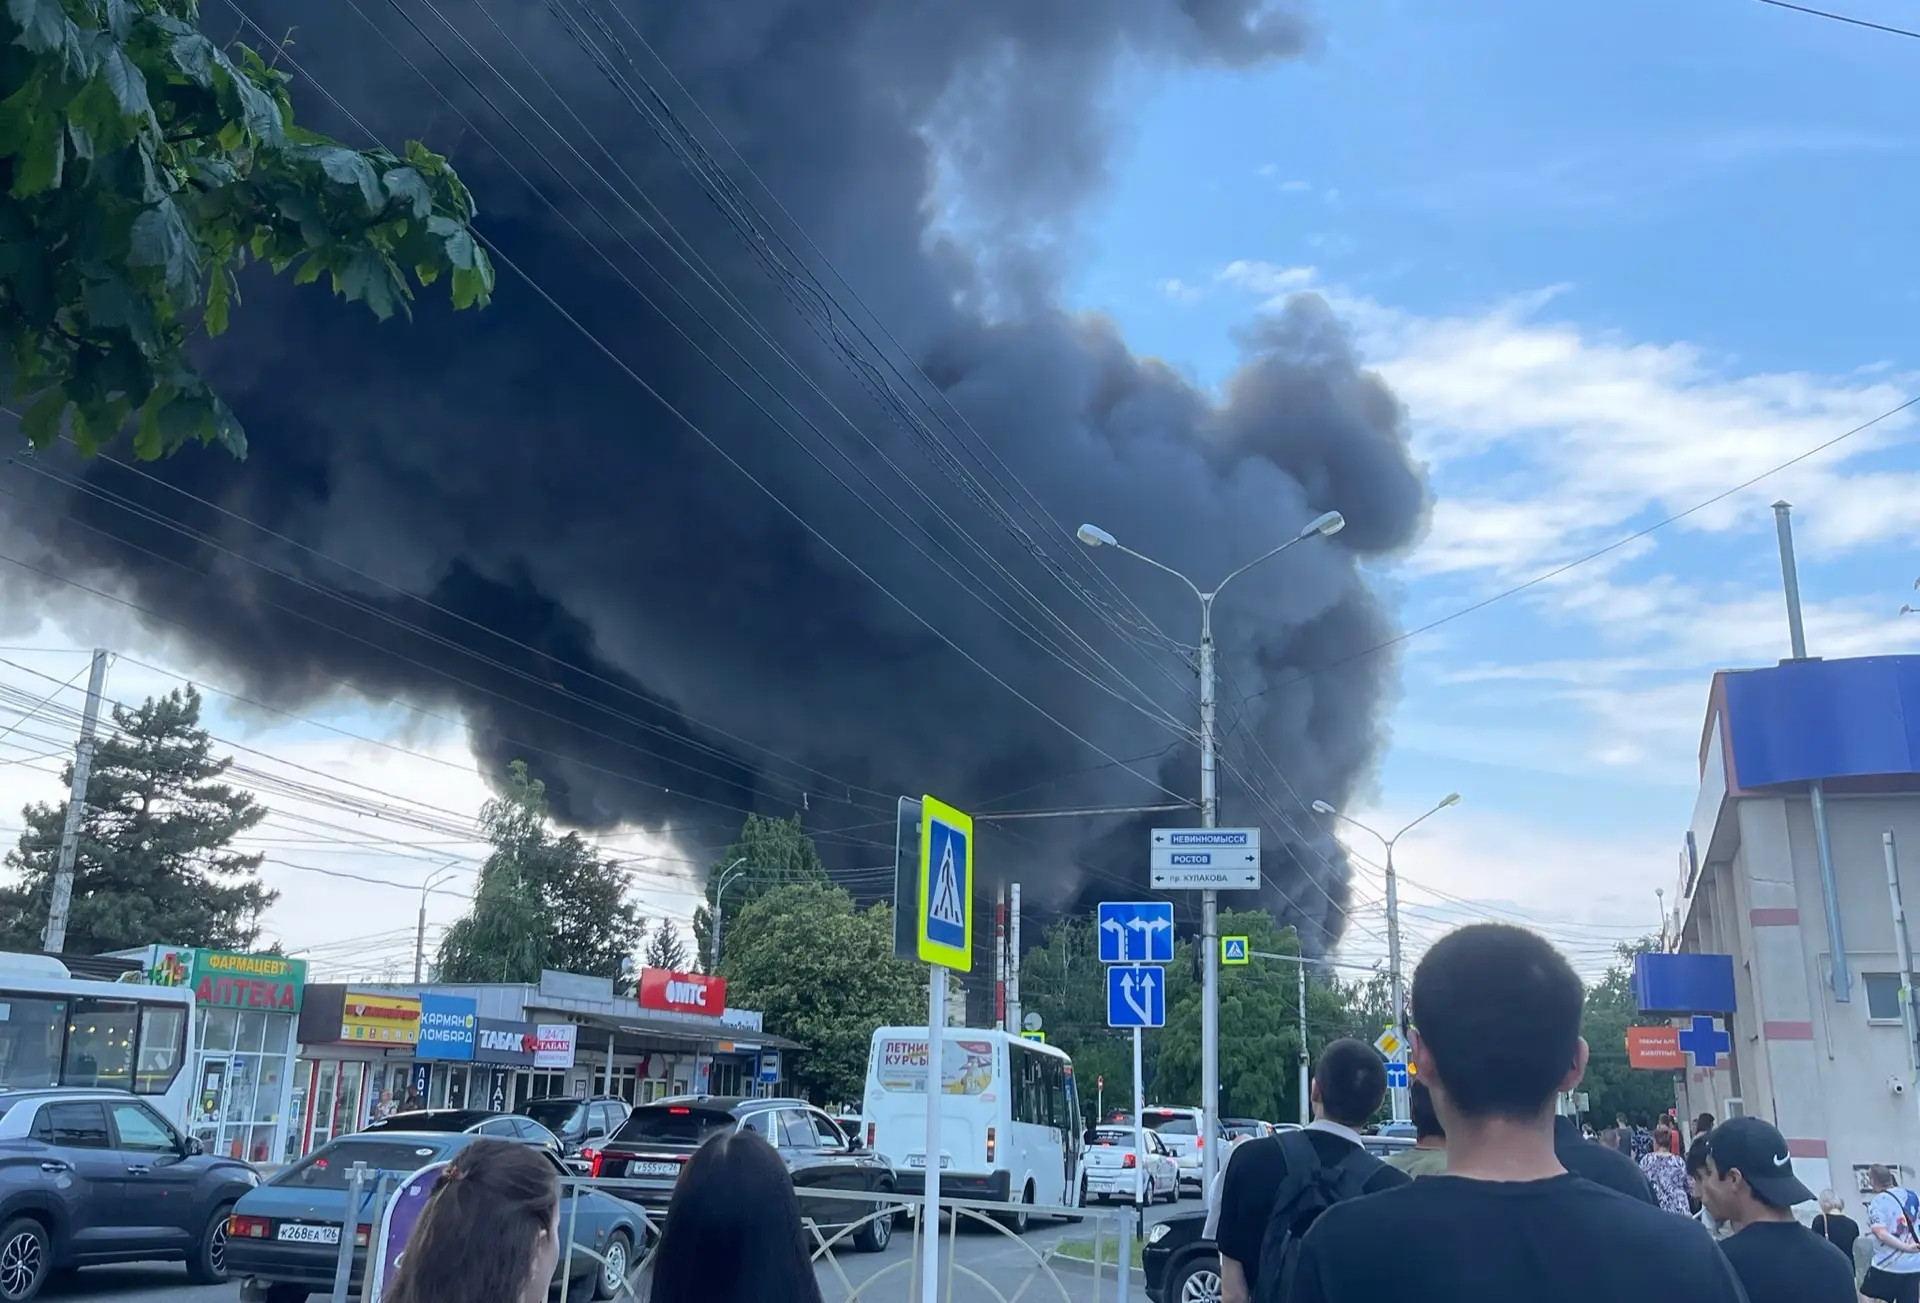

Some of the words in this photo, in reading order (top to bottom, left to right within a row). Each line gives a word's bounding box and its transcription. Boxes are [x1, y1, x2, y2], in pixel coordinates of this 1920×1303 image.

[1172, 835, 1245, 843] НЕВИННОМЫССК
[1174, 855, 1208, 863] РОСТОВ
[1183, 874, 1228, 882] КУЛАКОВА
[196, 977, 294, 1008] АПТЕКА
[675, 982, 707, 1006] МТС
[419, 1028, 473, 1043] ЛОМБАРД
[480, 1029, 525, 1053] ТАБАК
[540, 1041, 569, 1051] ТАБАК
[281, 1226, 319, 1240] К268ЕА
[323, 1228, 337, 1239] 126
